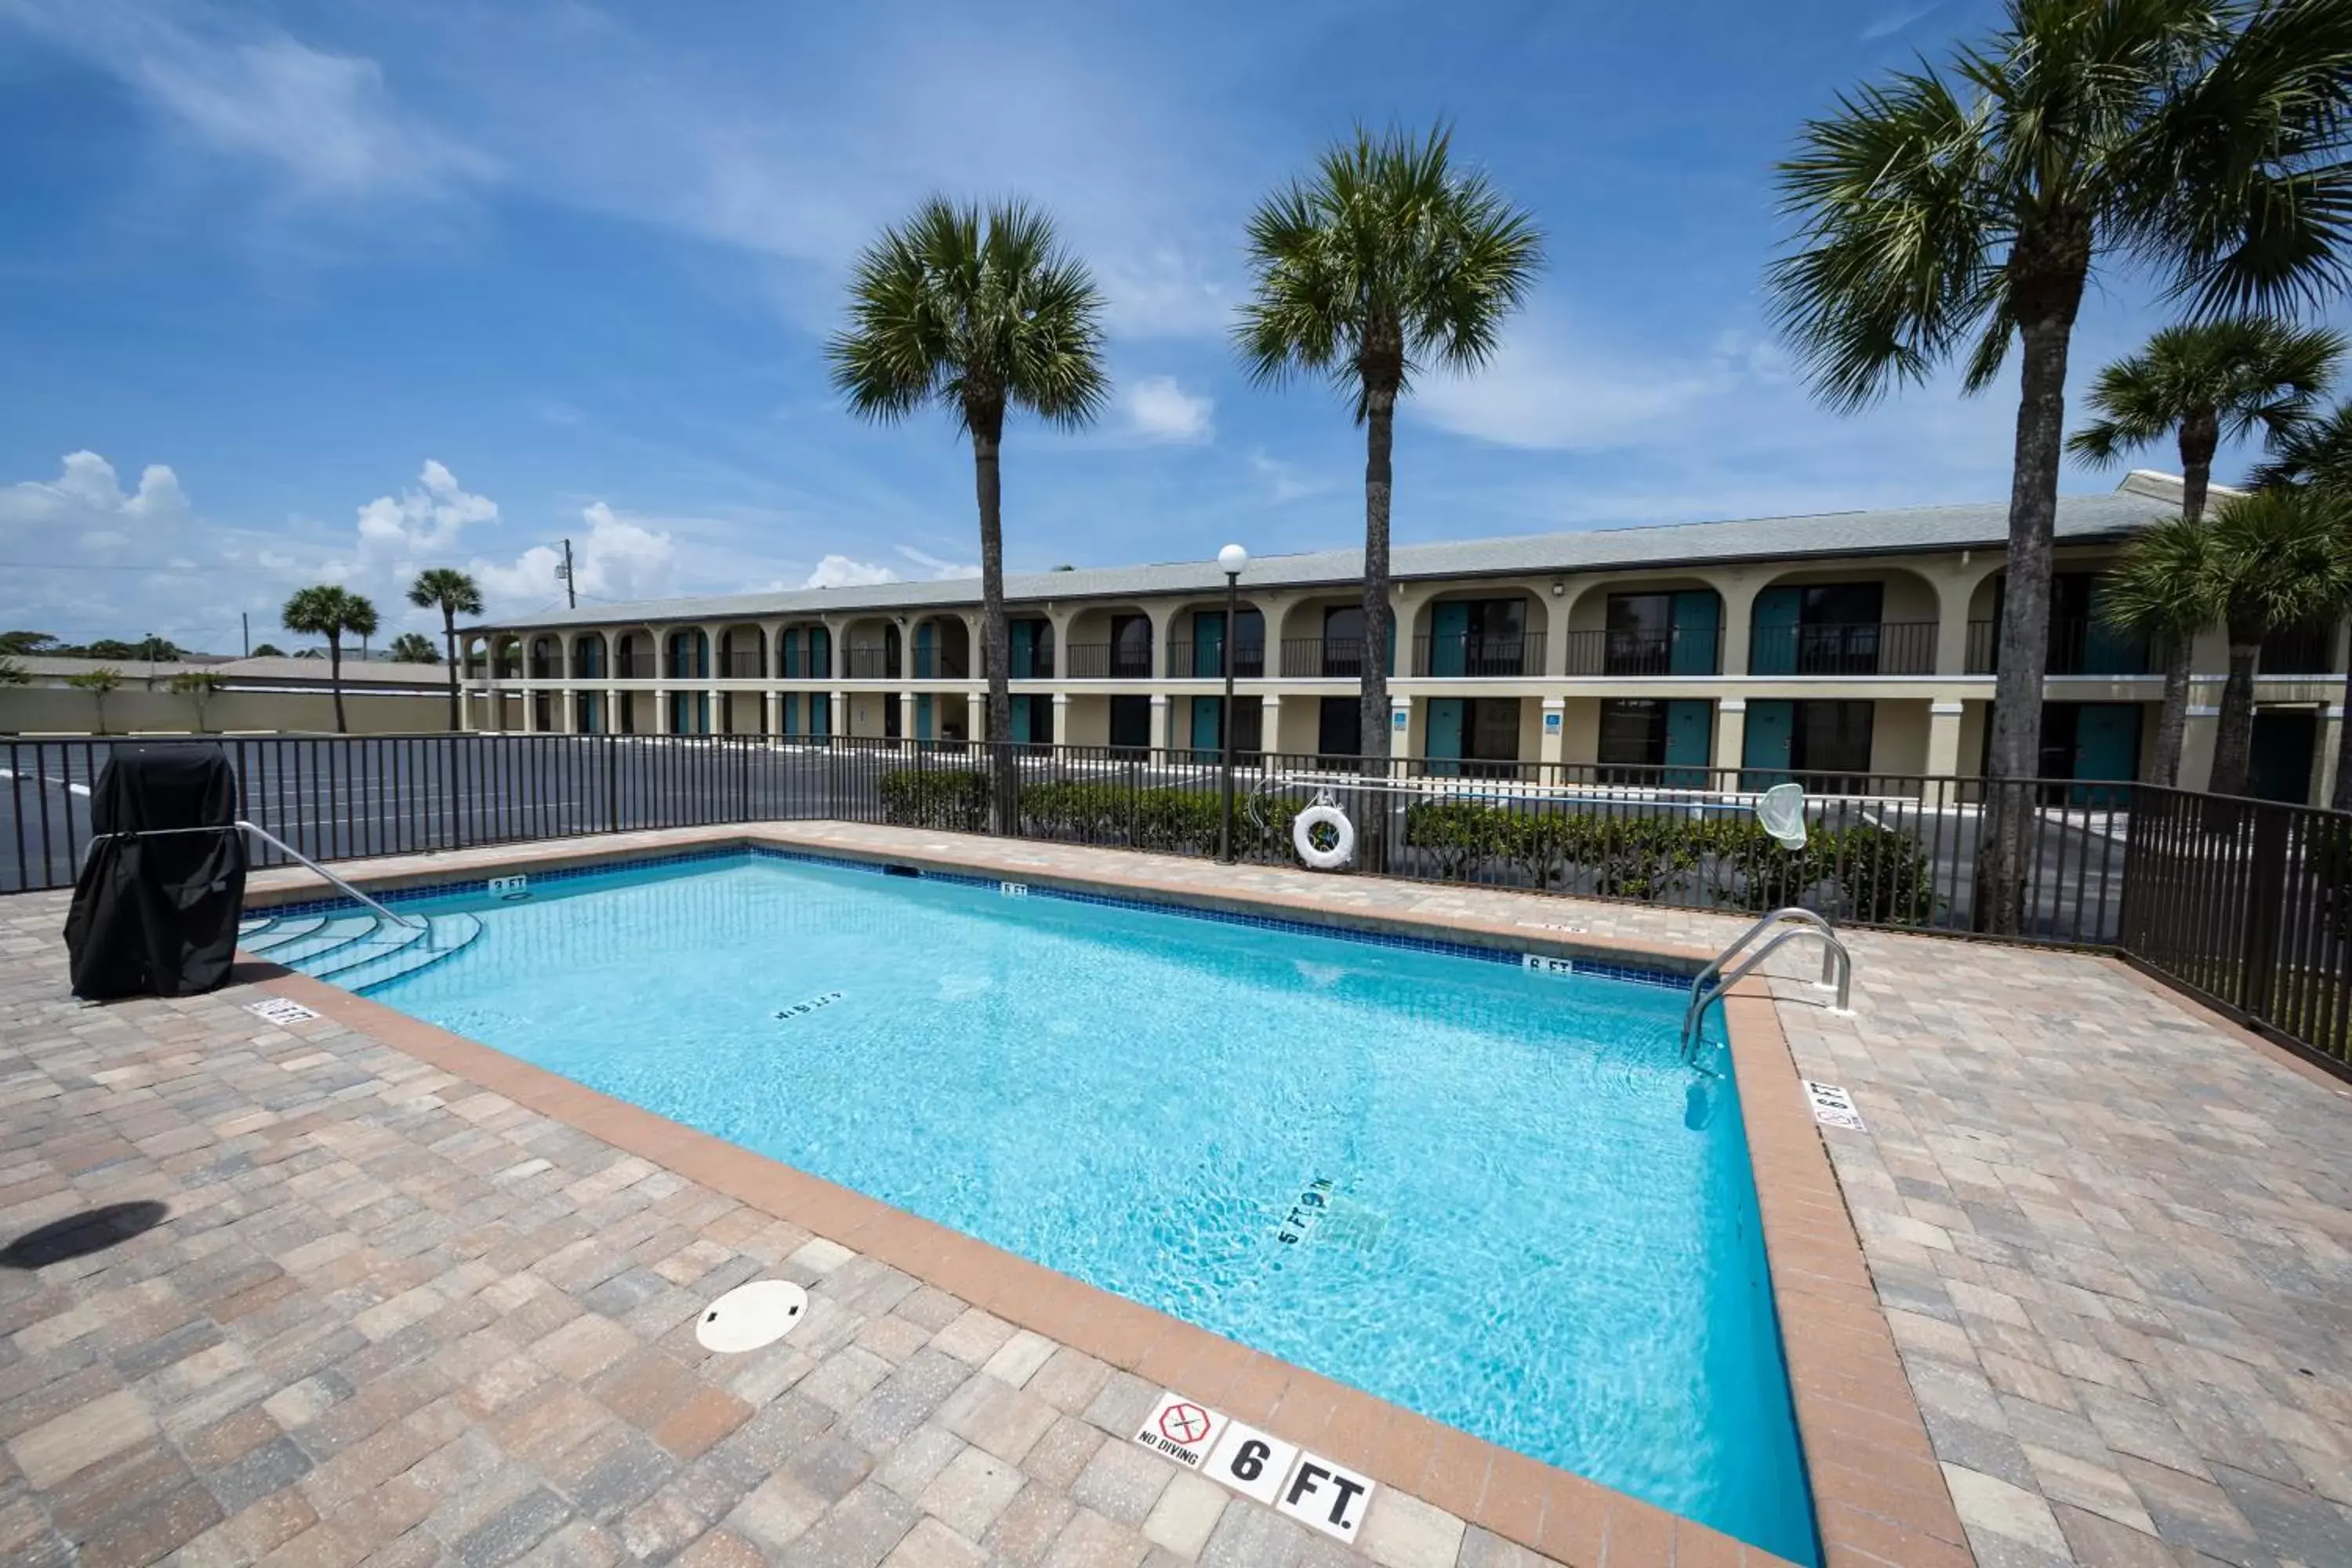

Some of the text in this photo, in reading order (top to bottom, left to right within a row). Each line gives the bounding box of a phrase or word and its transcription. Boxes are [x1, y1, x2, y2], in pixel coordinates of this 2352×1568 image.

[1138, 1430, 1199, 1465] NO DIVING
[1230, 1439, 1366, 1530] 6 FT.
